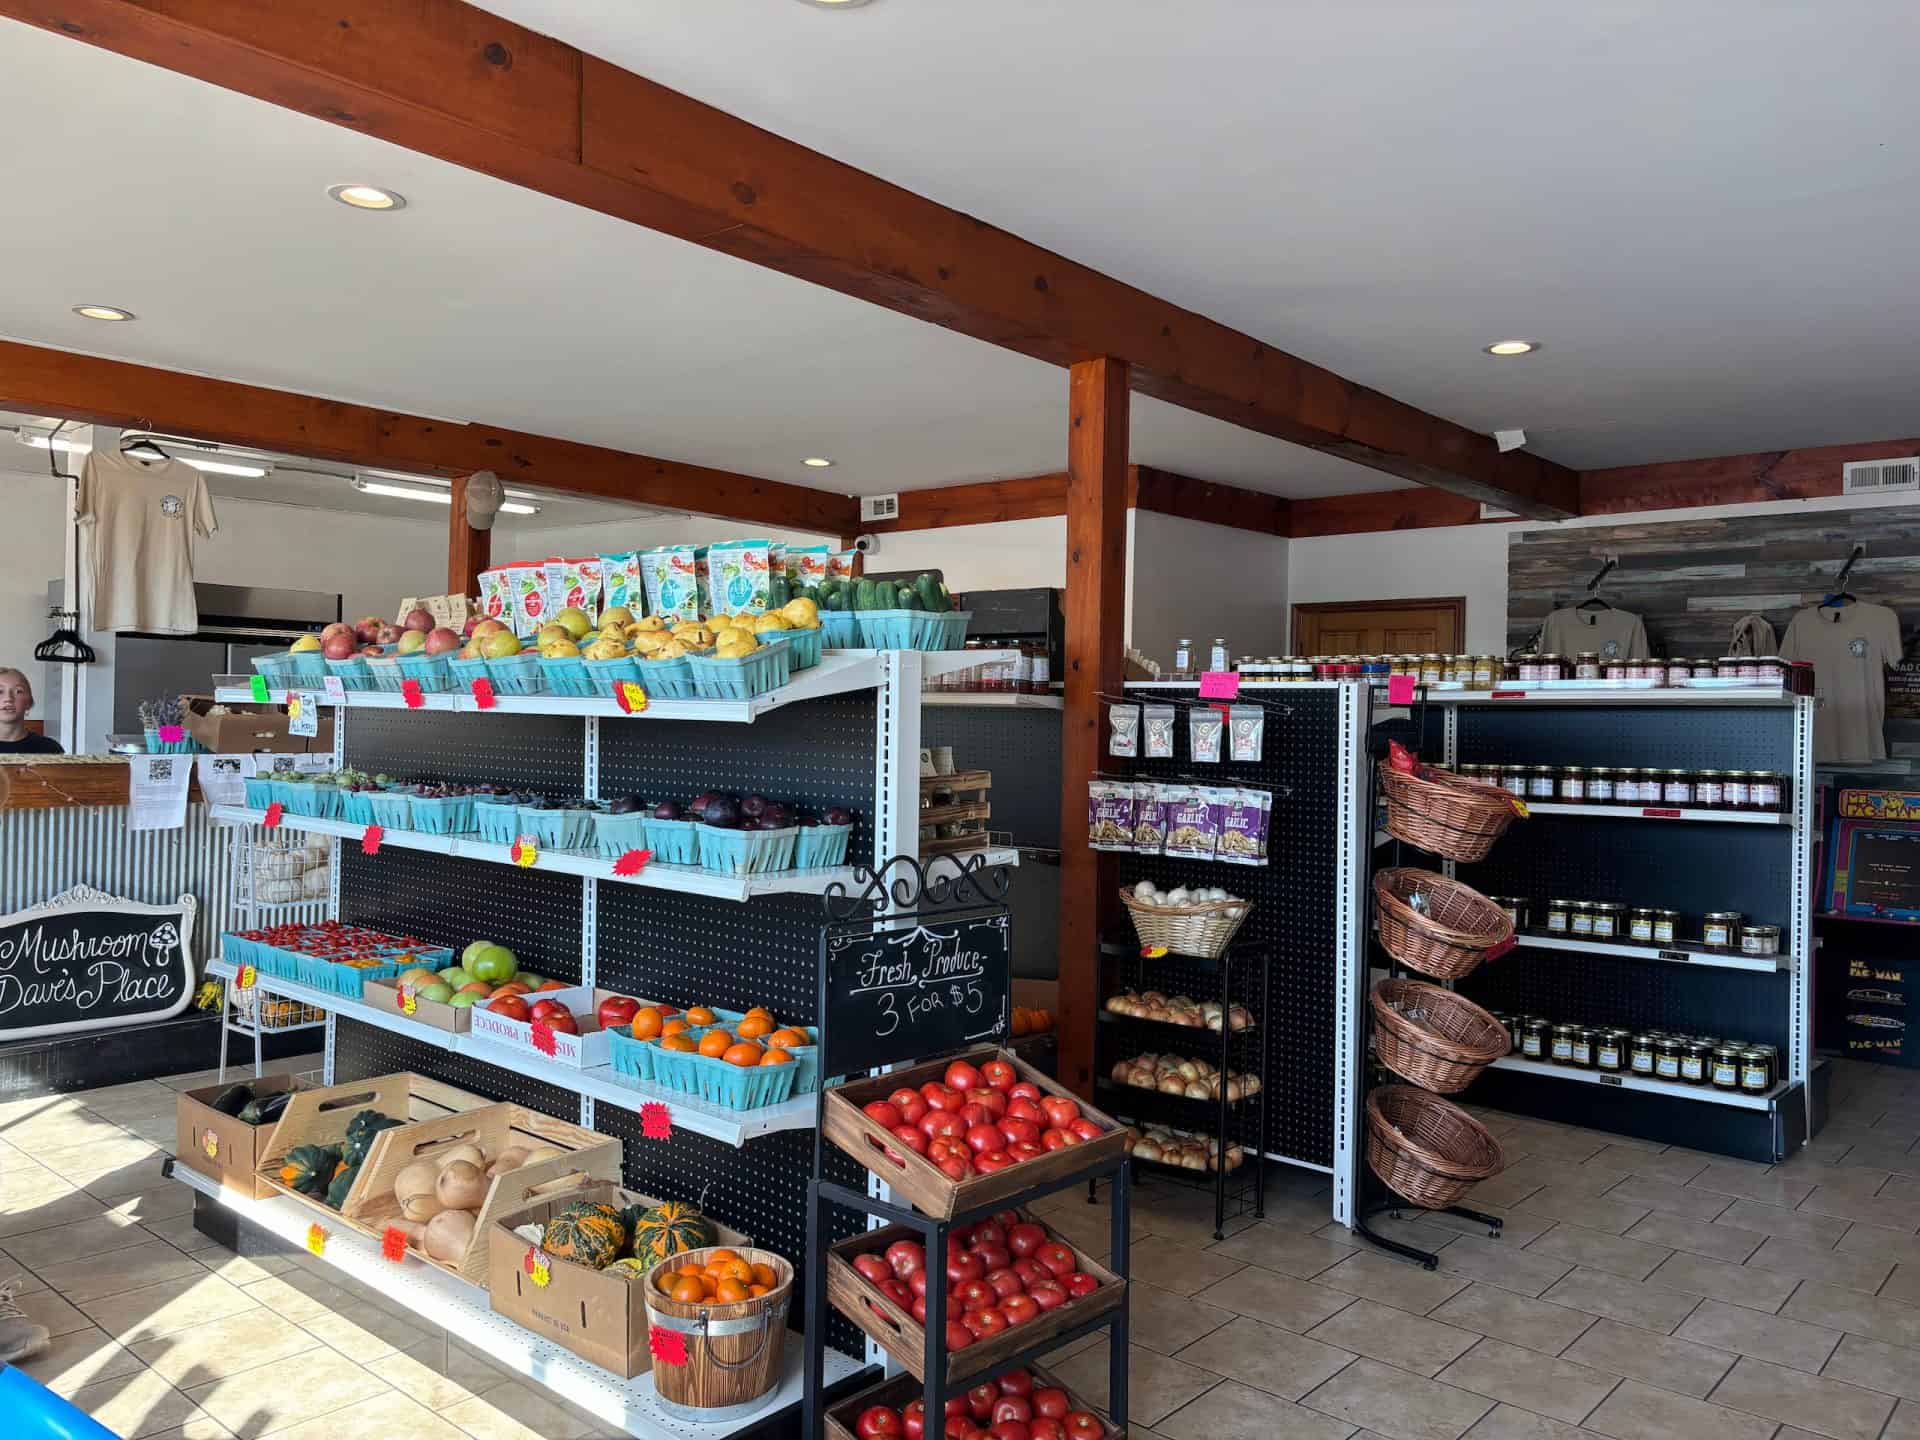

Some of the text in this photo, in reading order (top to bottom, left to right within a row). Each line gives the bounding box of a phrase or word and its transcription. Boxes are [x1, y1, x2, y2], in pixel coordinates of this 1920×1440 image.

[1176, 812, 1205, 824] GARLIC
[1225, 816, 1249, 829] GARLIC
[0, 924, 151, 974] Mushroom
[0, 961, 175, 1014] Dave's Place
[875, 979, 984, 1037] 3 FOR $5
[474, 1014, 519, 1041] PRODUCE
